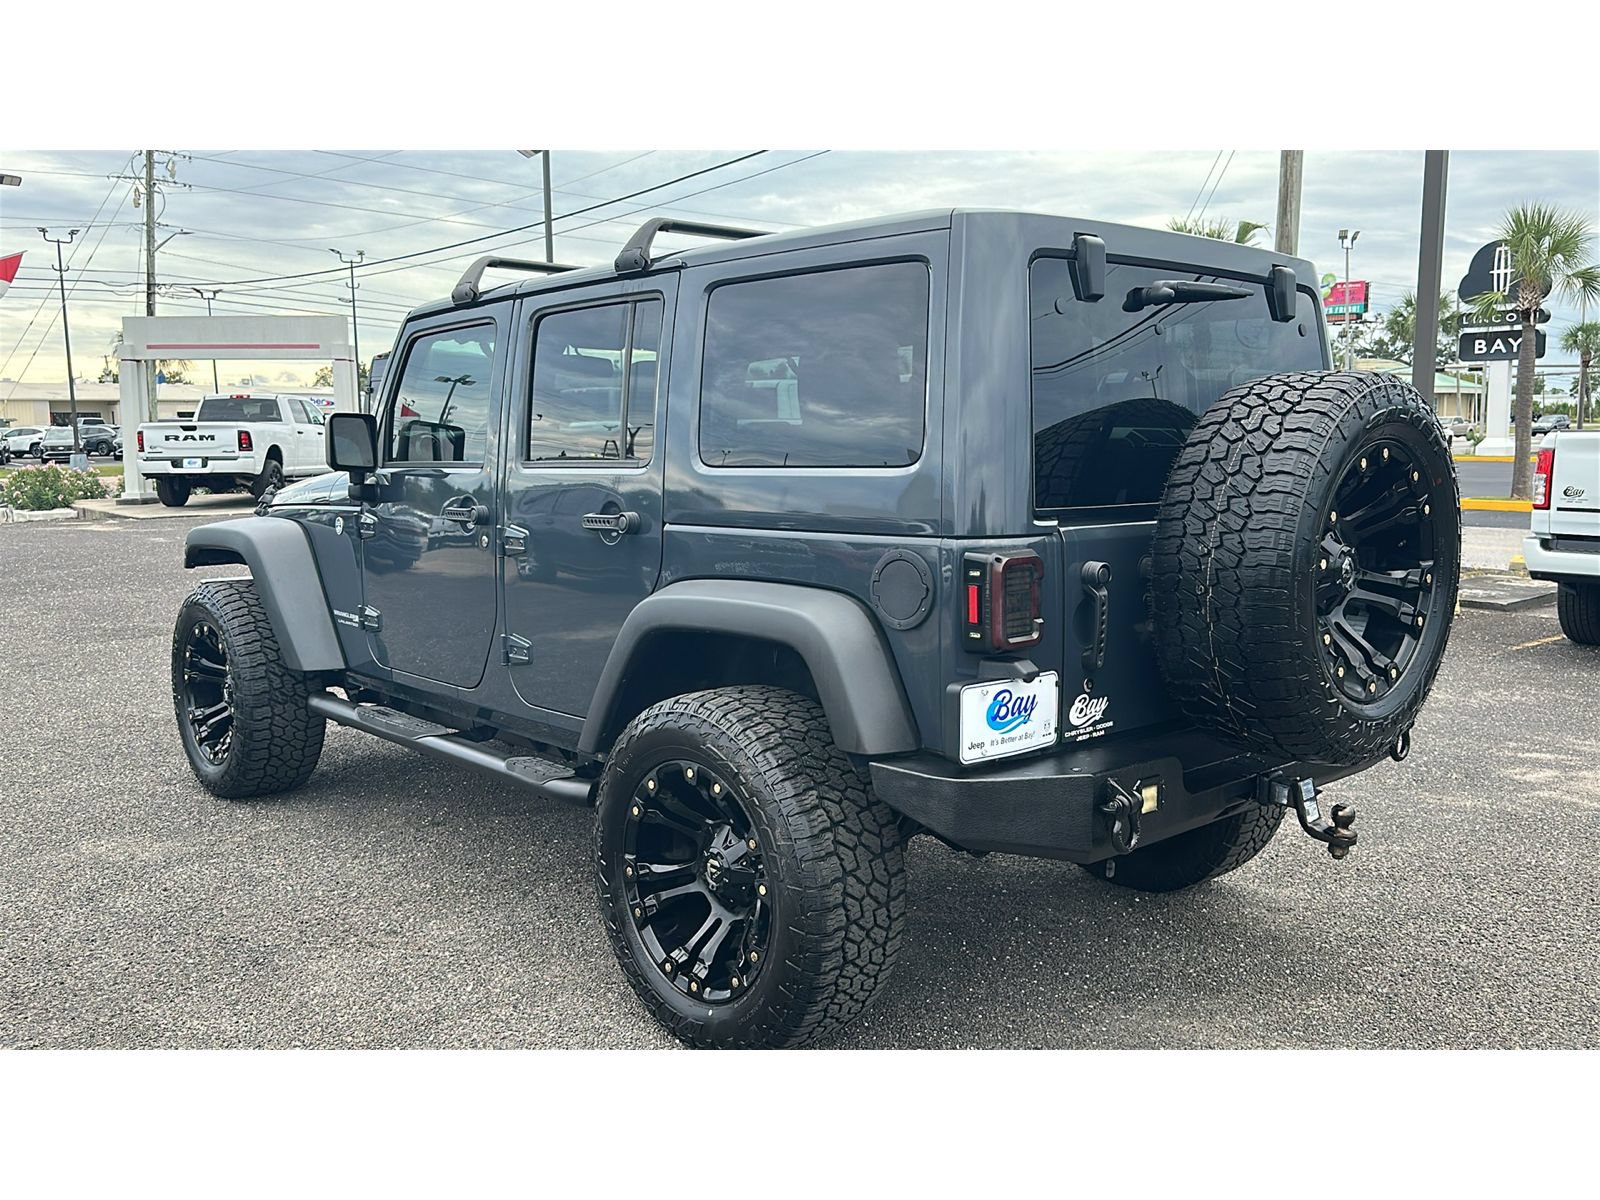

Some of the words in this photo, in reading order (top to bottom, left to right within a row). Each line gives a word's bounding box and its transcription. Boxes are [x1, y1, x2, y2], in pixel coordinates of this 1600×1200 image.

[1474, 337, 1523, 354] BAY
[1563, 486, 1585, 498] Bay
[986, 689, 1038, 727] Bay
[1069, 694, 1109, 727] Bay
[1064, 726, 1094, 737] CHRYSLER
[1076, 733, 1090, 741] JEEP
[968, 741, 985, 750] Jeep
[990, 738, 999, 746] It's
[1000, 736, 1017, 745] Better
